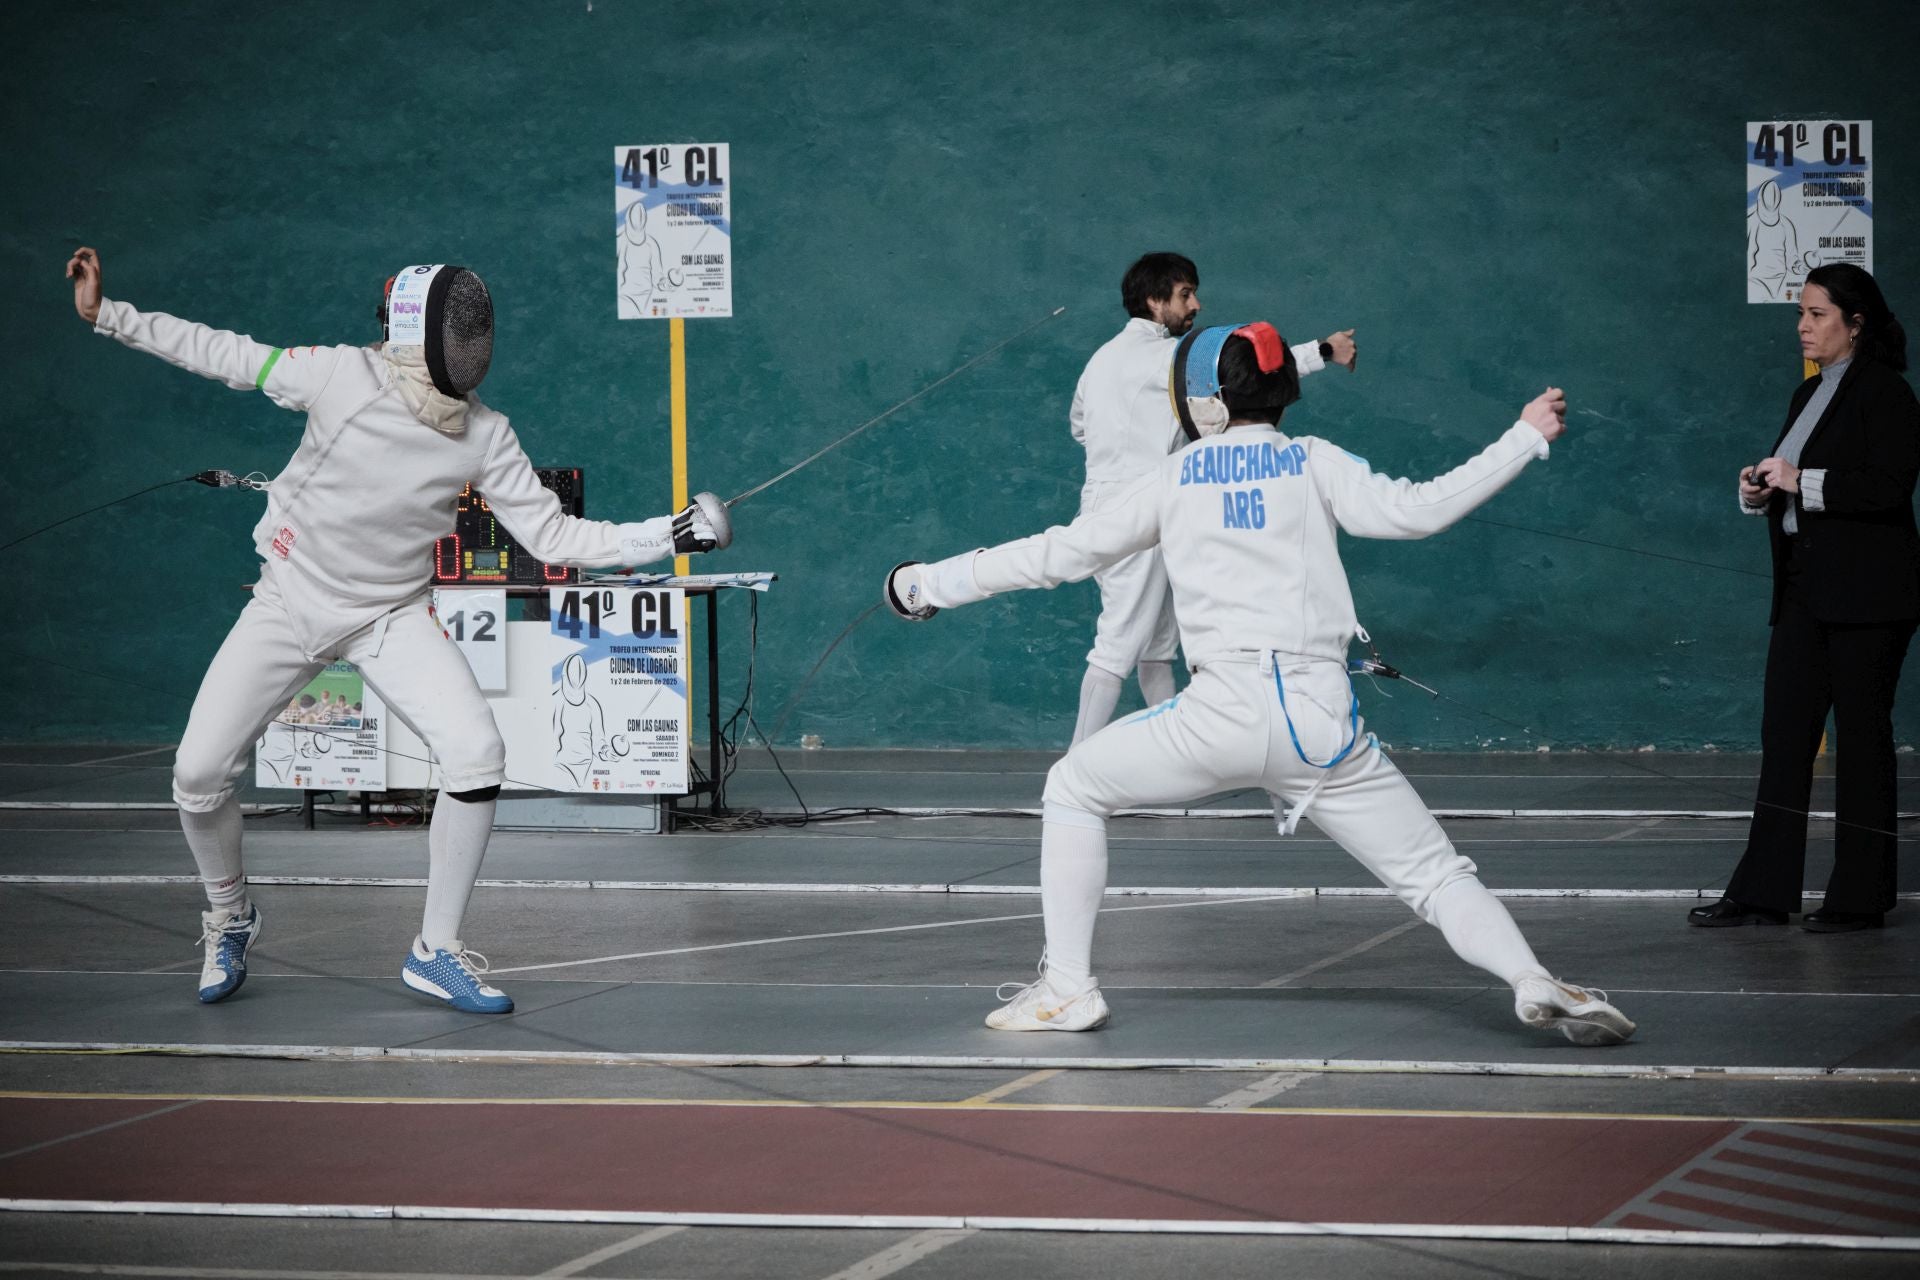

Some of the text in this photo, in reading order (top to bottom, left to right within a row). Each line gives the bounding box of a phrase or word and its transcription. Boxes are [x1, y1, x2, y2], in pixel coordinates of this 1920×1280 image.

[1753, 123, 1866, 166] 41º CL
[622, 147, 723, 189] 41º CL
[1803, 180, 1865, 197] CIUDAD DE LOGROÑO
[666, 203, 688, 217] CIUDAD
[698, 199, 723, 216] LOGROÑO
[1833, 237, 1842, 248] LAS
[1844, 237, 1865, 248] GAUNAS
[694, 255, 703, 265] LAS
[1180, 442, 1307, 486] BEAUCHAMP
[1224, 488, 1266, 529] ARG
[558, 590, 677, 639] 41º CL
[447, 611, 497, 642] 12
[610, 646, 677, 654] TROFEO INTERNACIONAL
[610, 655, 678, 674] CIUDAD DE LOGROÑO
[362, 718, 377, 731] UNAS
[642, 719, 653, 732] LAS
[654, 719, 678, 732] GAUNAS
